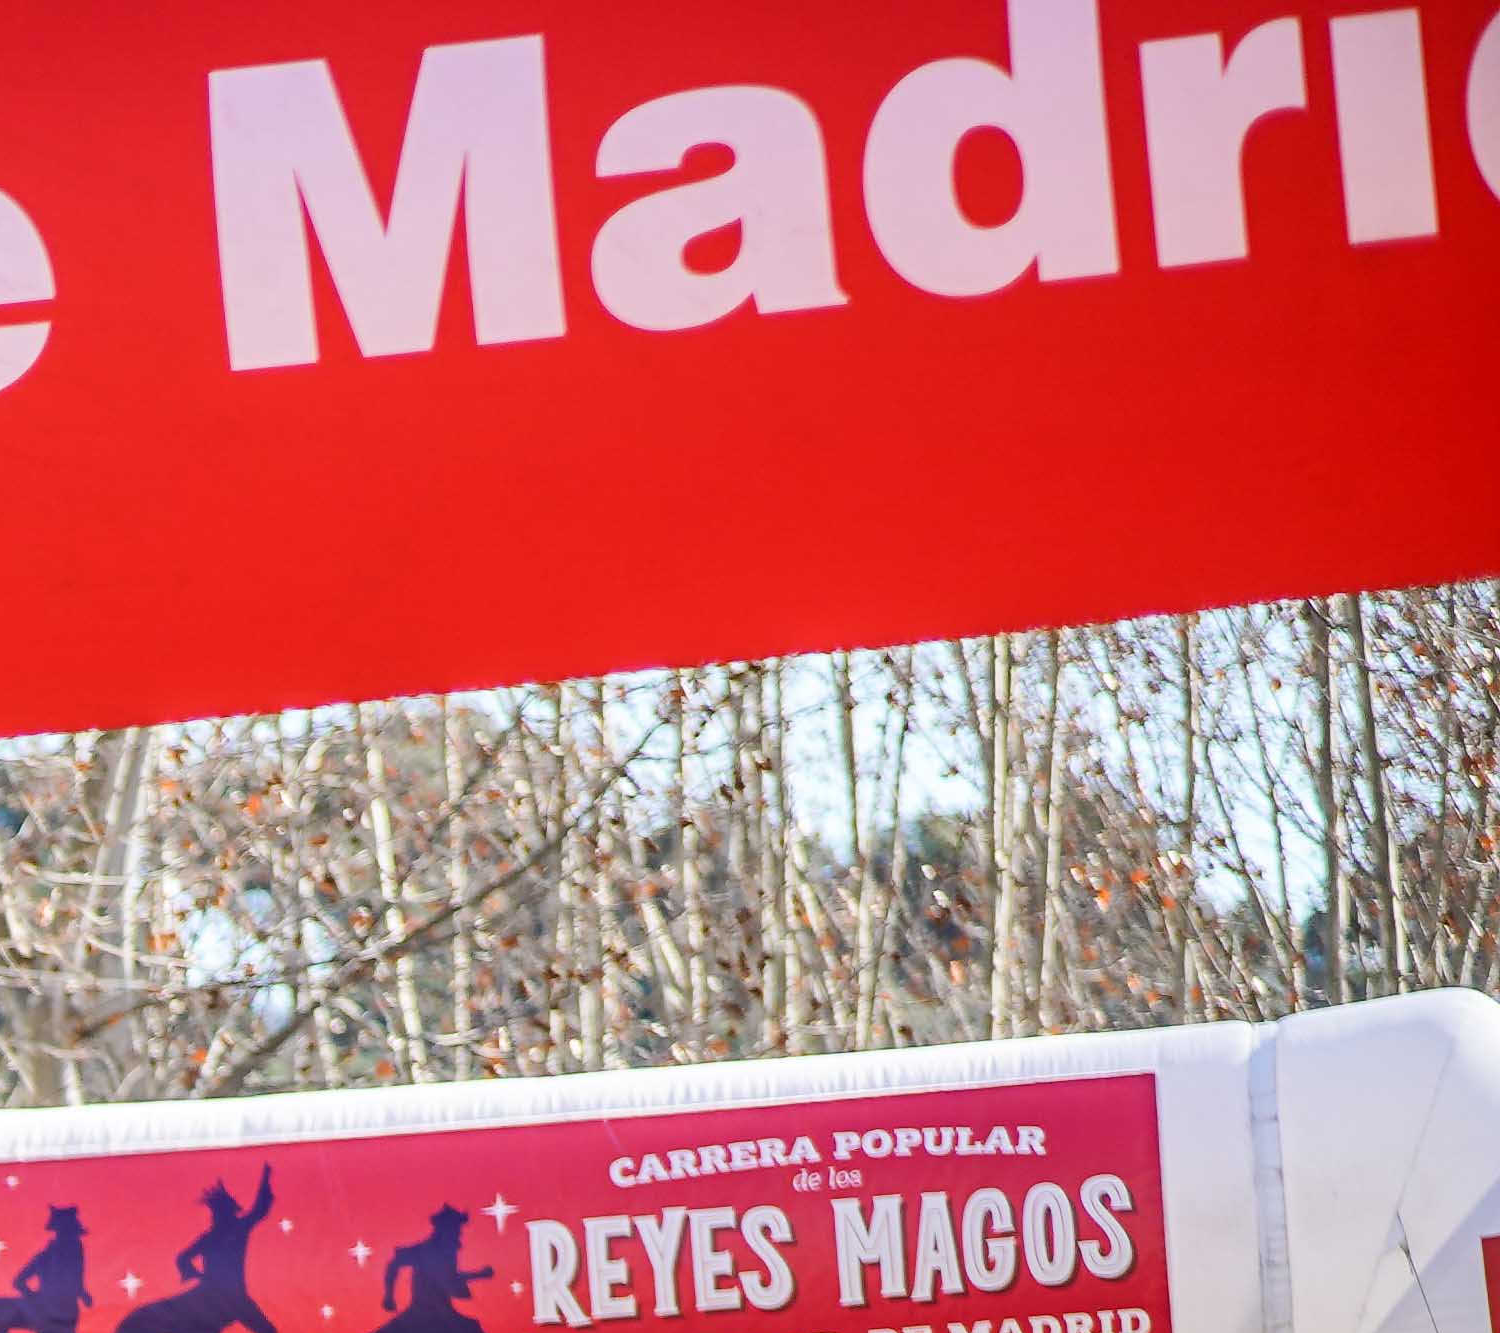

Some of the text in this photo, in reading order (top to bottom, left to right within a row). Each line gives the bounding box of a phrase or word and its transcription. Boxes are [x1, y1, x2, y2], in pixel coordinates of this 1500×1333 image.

[608, 1125, 1047, 1188] CARRERA POPULAR
[791, 1165, 863, 1192] de los
[525, 1173, 1134, 1329] REYES MAGOS
